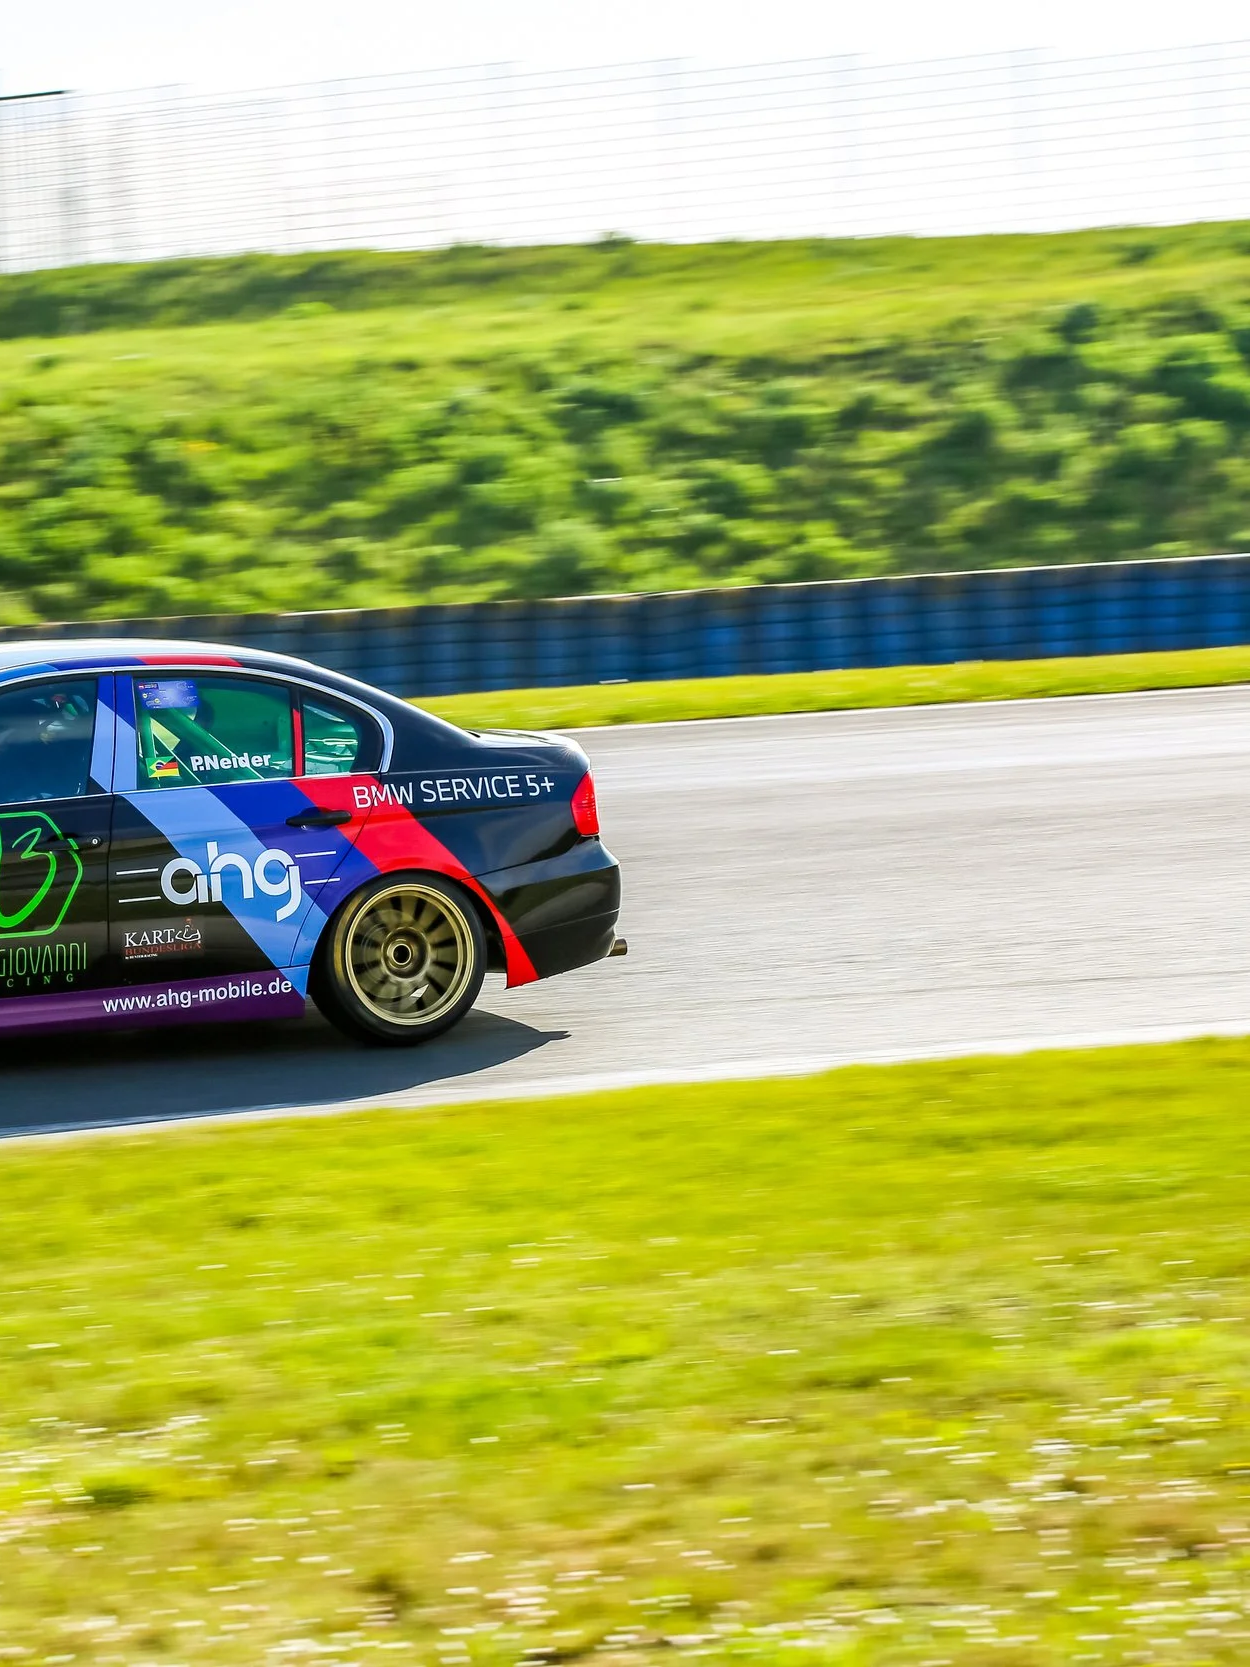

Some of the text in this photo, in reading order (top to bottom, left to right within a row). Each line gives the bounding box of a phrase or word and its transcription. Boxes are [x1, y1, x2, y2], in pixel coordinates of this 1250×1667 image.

[190, 752, 271, 772] P.Neider
[352, 774, 555, 808] BMW SERVICE 5+
[160, 841, 302, 923] ahg
[124, 928, 175, 948] KART
[125, 942, 202, 956] BUNDESLIGA
[102, 977, 292, 1013] www.ahg-mobile.de
